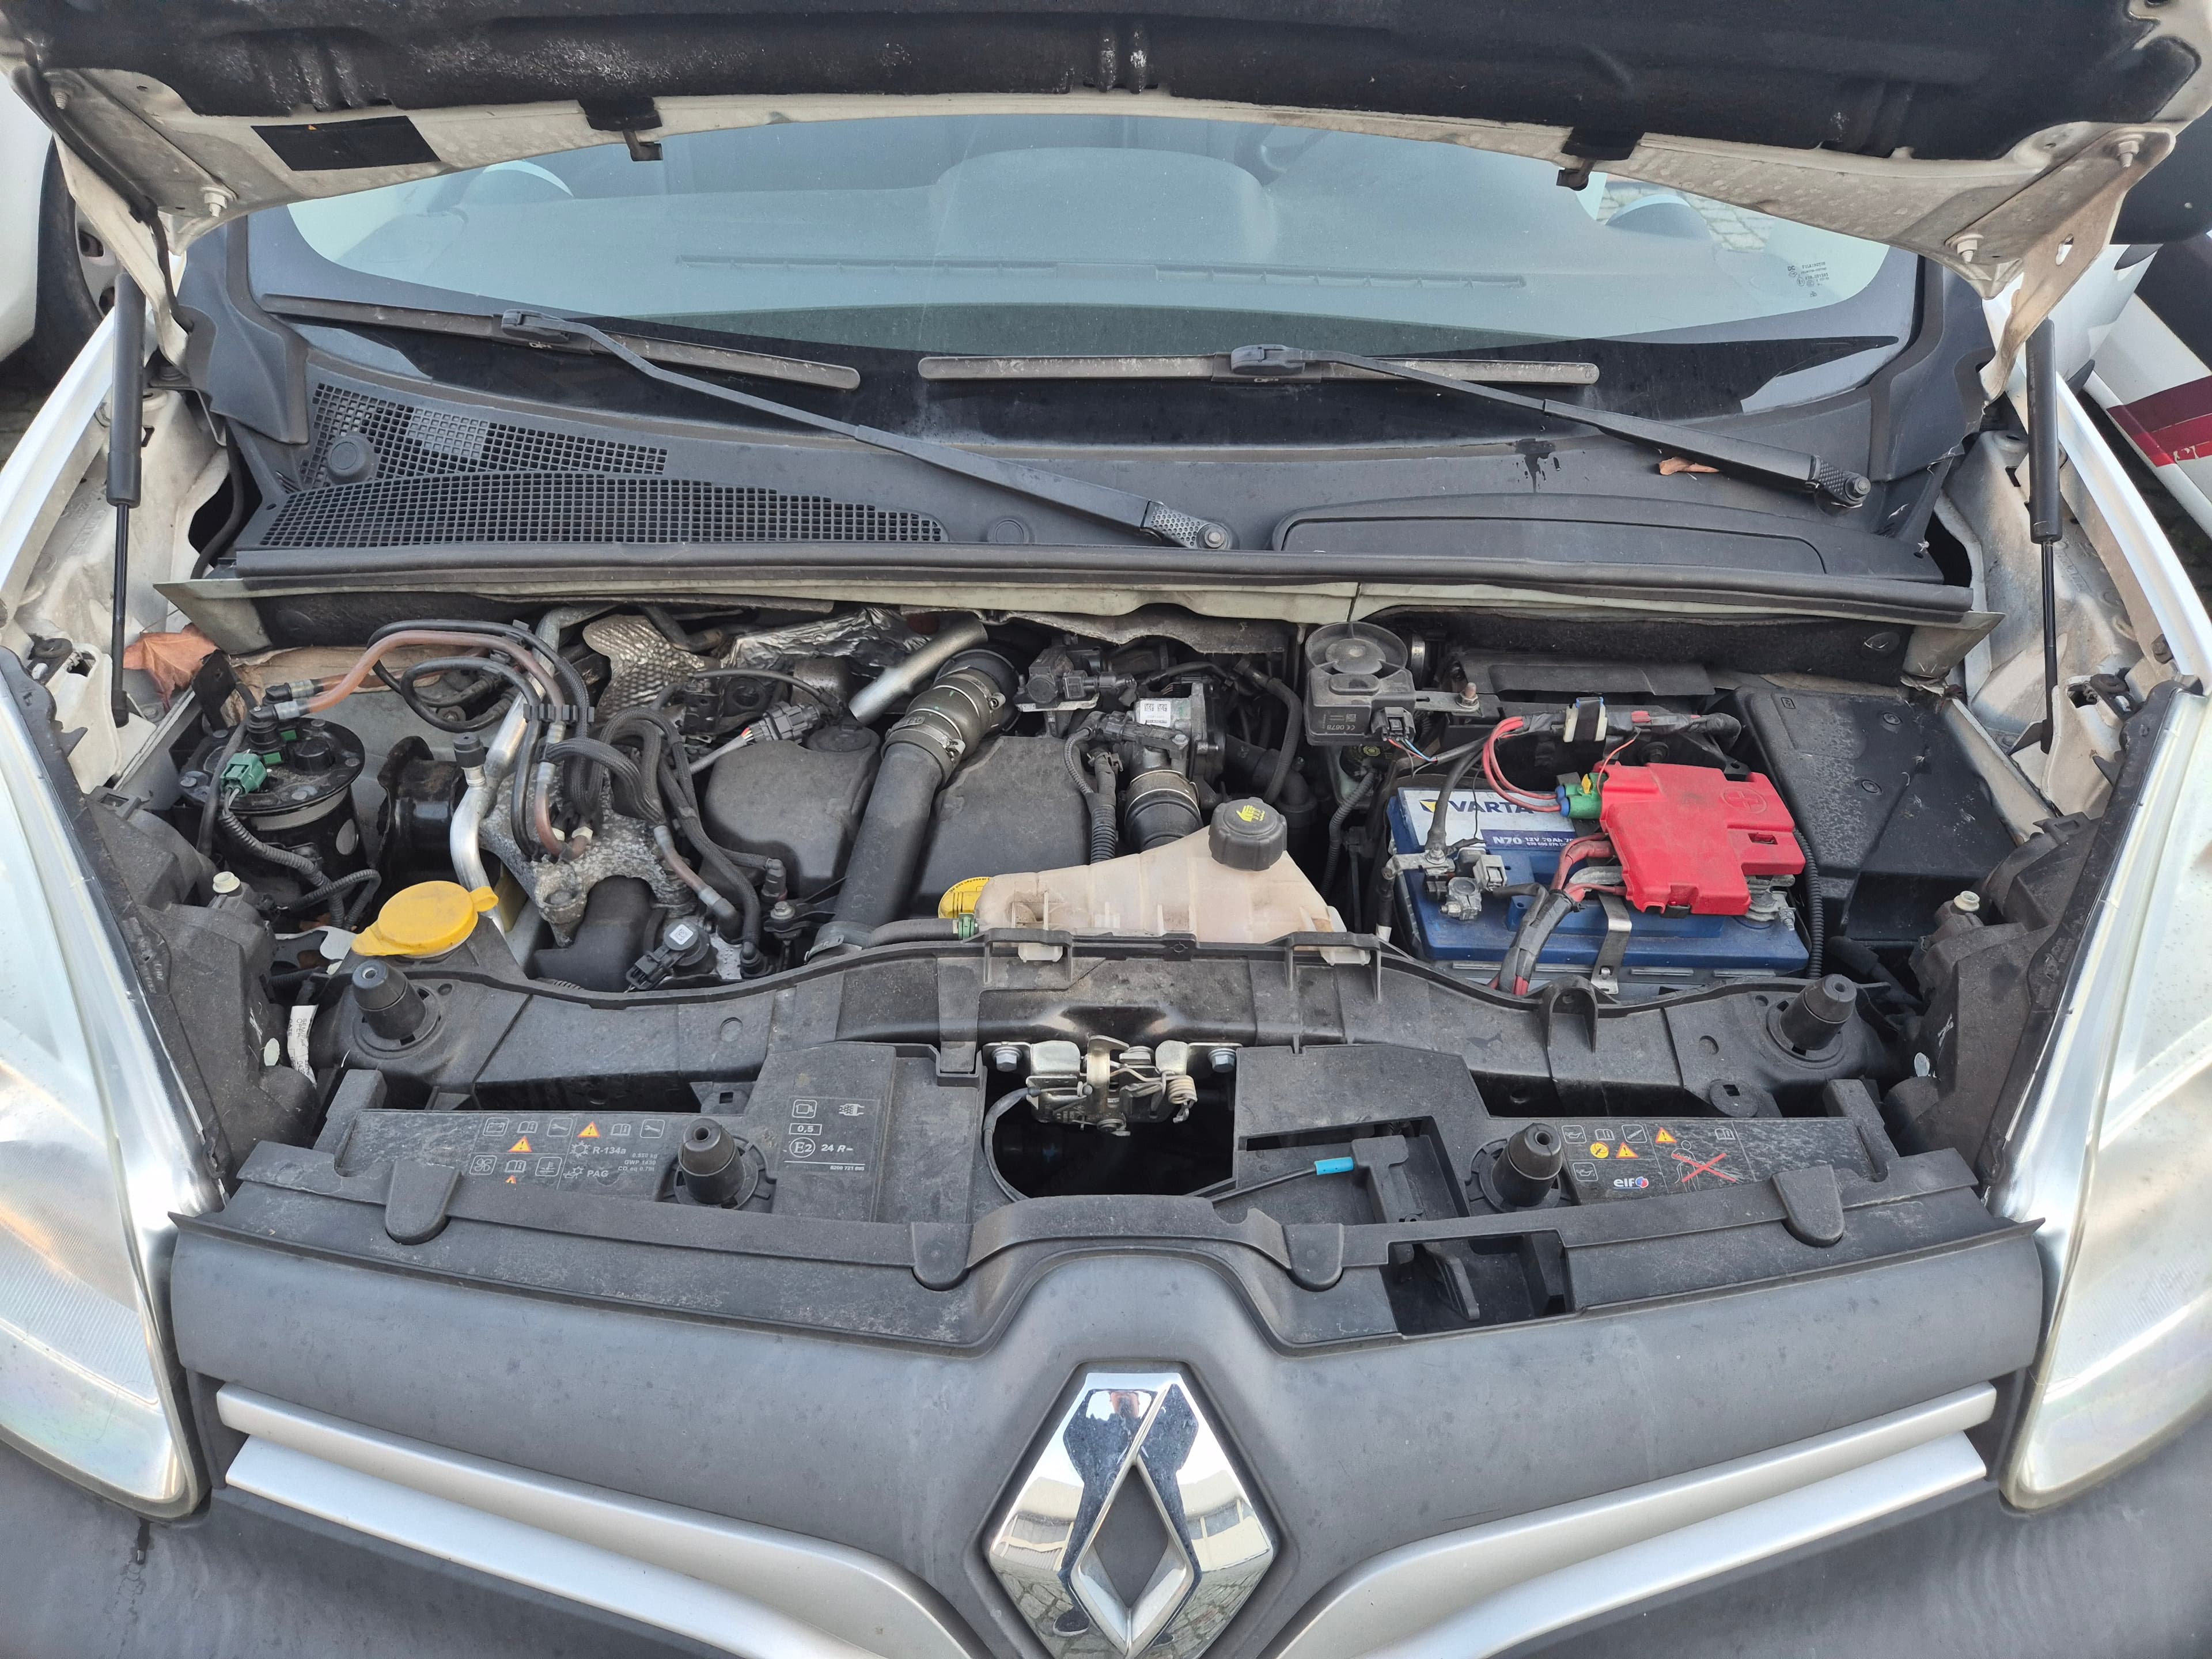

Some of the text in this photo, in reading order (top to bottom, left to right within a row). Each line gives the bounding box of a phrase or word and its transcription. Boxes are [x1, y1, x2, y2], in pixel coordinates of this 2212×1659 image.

[1493, 836, 1522, 845] N70
[797, 1125, 814, 1133] 0,5
[592, 1146, 627, 1154] R-134a
[793, 1141, 813, 1154] E2
[821, 1143, 835, 1152] 24
[1613, 1178, 1635, 1187] elf
